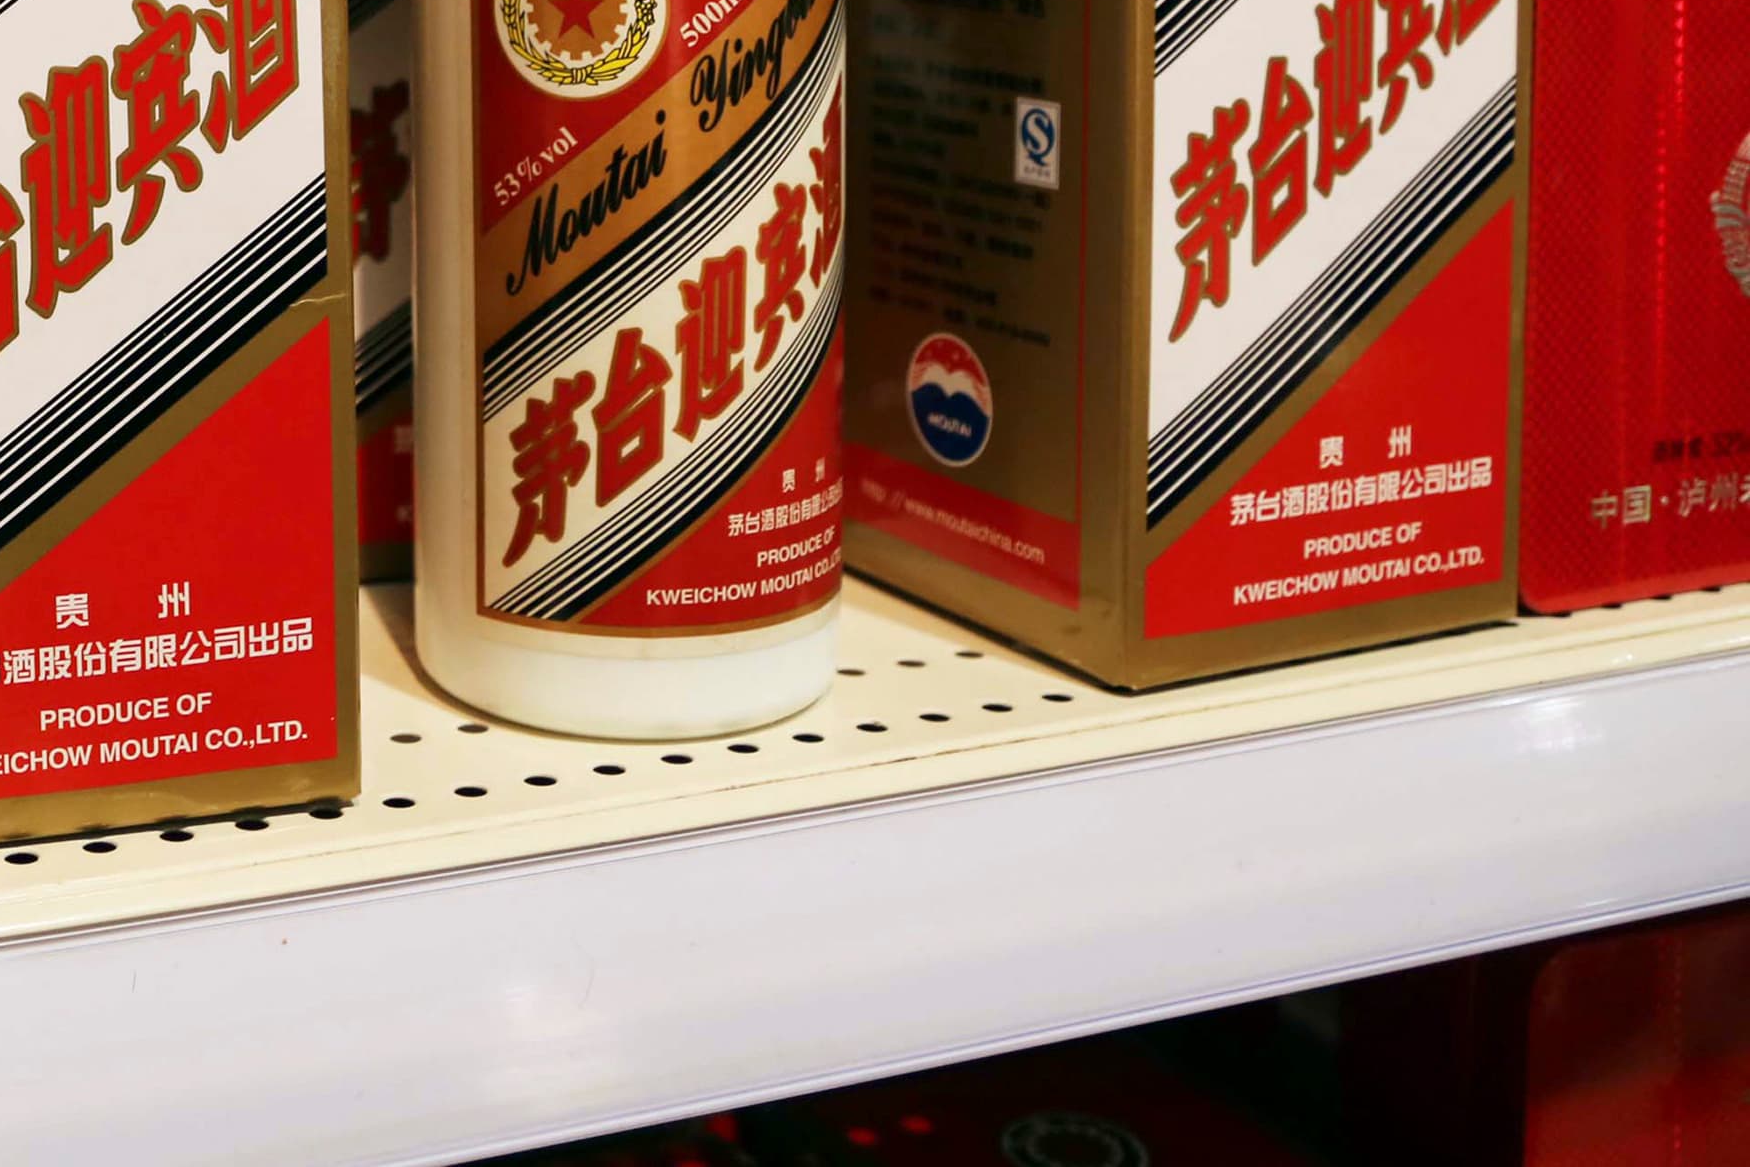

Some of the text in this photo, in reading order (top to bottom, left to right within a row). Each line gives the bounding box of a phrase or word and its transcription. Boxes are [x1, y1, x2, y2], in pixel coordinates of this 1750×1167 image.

[506, 110, 667, 295] Moutai
[1229, 456, 1492, 527] 茅台酒股份有限公司出品
[757, 533, 822, 567] PRODUCE
[1304, 522, 1422, 559] PRODUCE OF
[647, 582, 757, 605] KWEICHOW
[761, 566, 813, 596] MOUTAI
[1234, 570, 1338, 605] KWEICHOW
[1342, 557, 1410, 588] MOUTAI
[40, 693, 212, 731] PRODUCE OF
[100, 732, 198, 763] MOUTAI
[205, 720, 308, 749] CO.,LTD.
